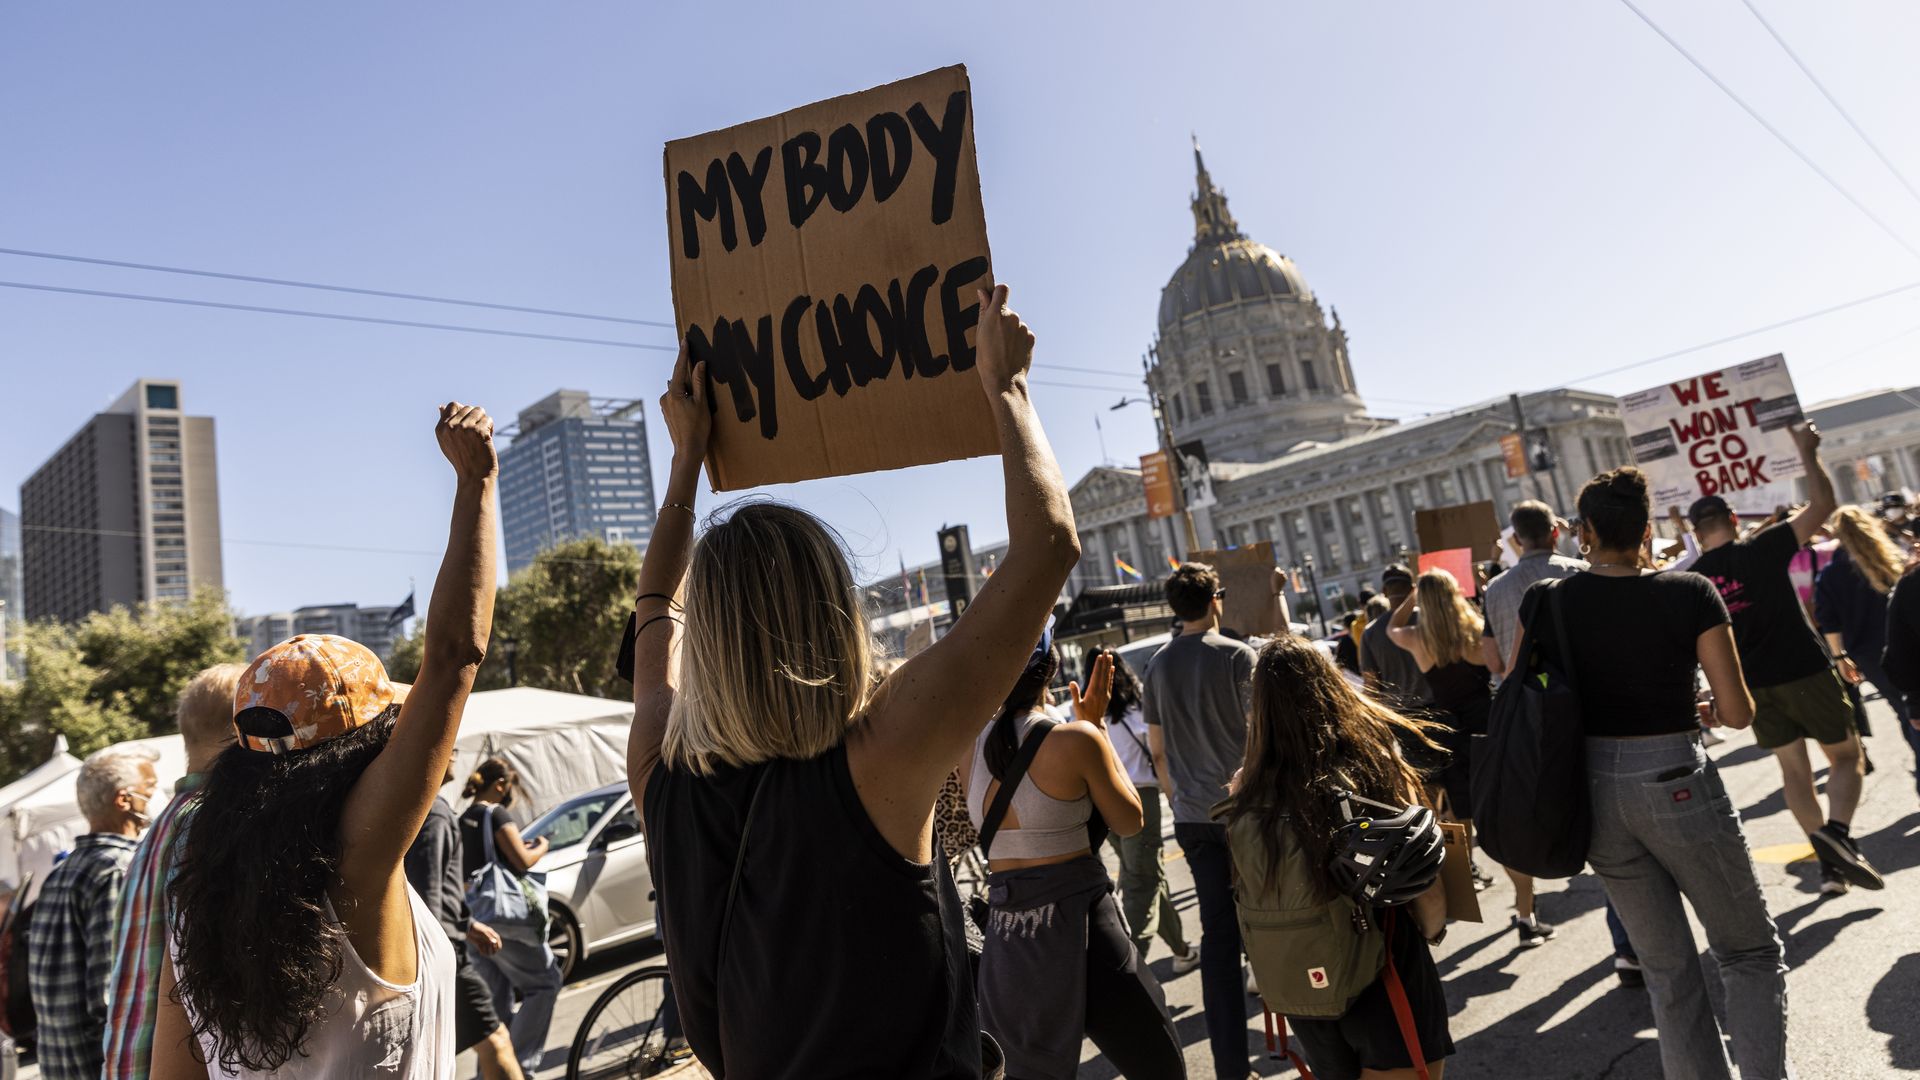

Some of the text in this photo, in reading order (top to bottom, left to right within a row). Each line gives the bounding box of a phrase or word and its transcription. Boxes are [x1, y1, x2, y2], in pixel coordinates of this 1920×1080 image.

[677, 90, 967, 259] MY BODY
[685, 256, 988, 440] MY CHOICE
[1669, 370, 1729, 407] WE
[1688, 434, 1748, 469] GO
[1695, 455, 1771, 496] BACK
